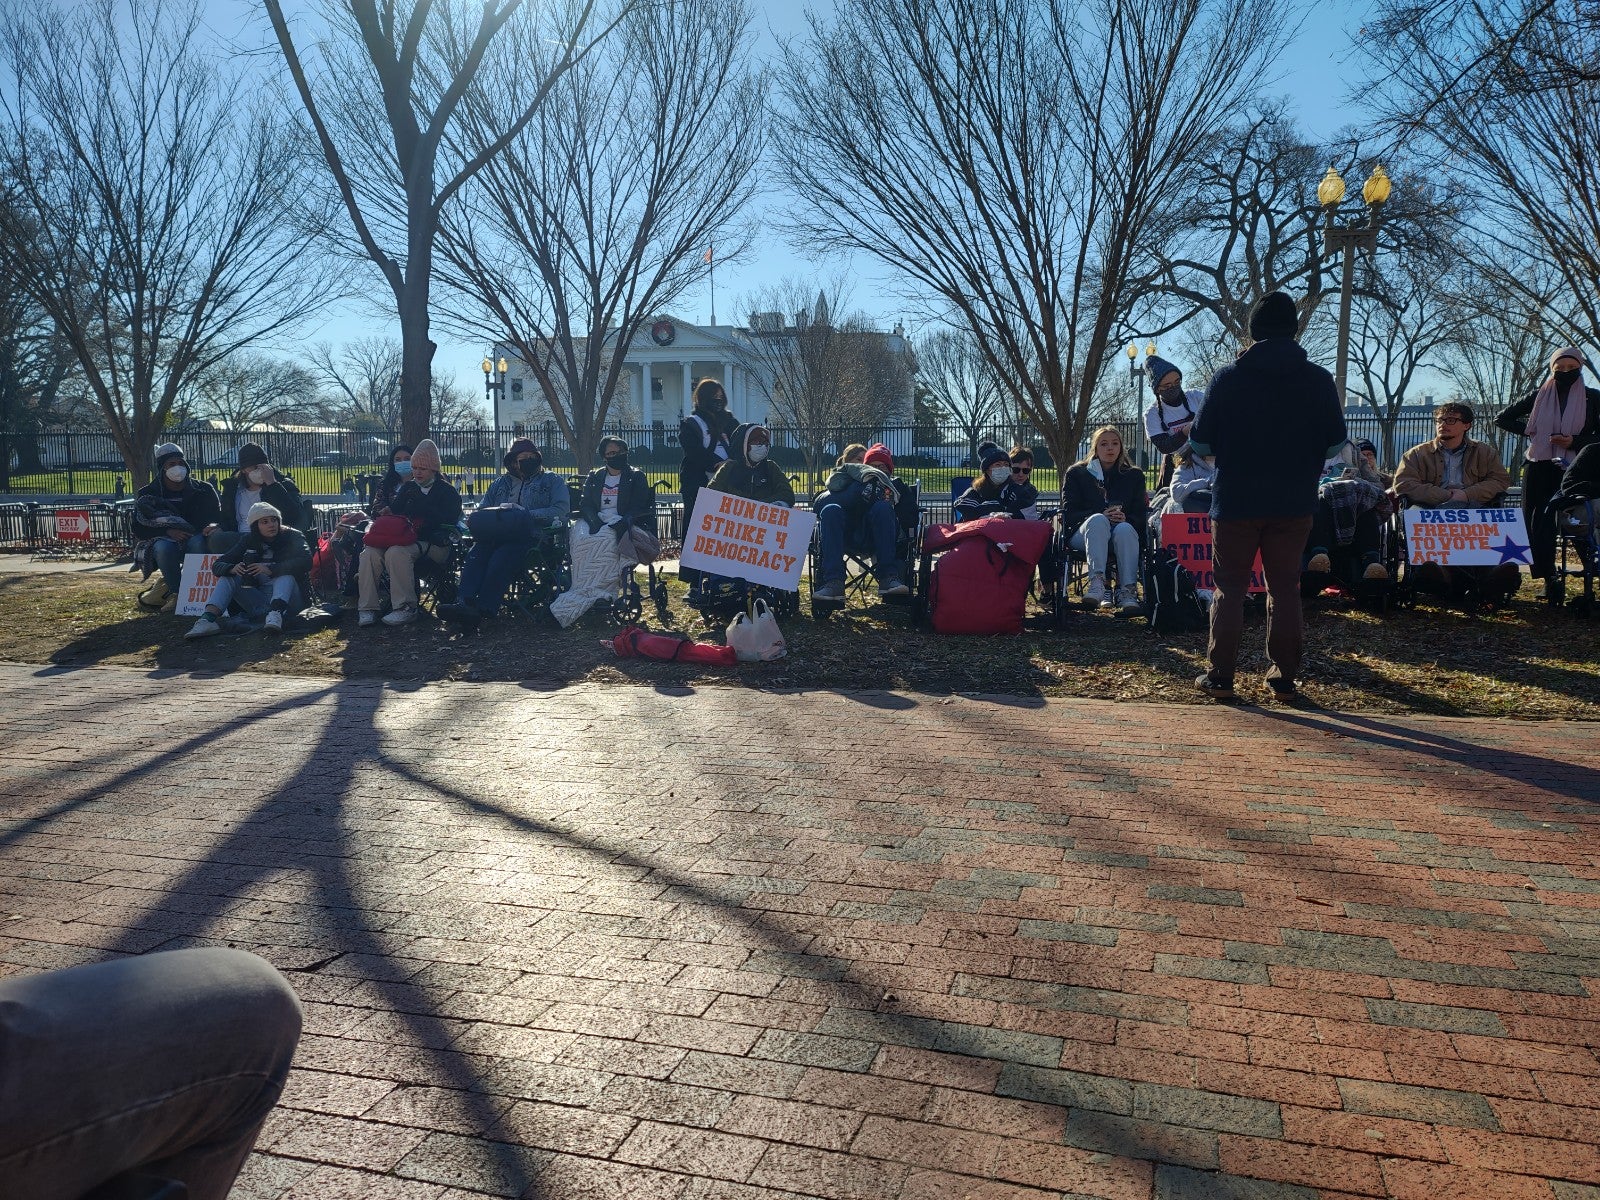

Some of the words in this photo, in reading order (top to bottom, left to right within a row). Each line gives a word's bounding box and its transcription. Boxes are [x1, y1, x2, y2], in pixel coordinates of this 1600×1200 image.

[719, 495, 790, 527] HUNGER
[1420, 509, 1470, 523] PASS
[1476, 508, 1517, 523] THE
[59, 518, 79, 527] EXIT
[1412, 523, 1500, 537] FREEDOM
[701, 514, 767, 545] STRIKE
[776, 531, 788, 550] 4
[1411, 537, 1436, 550] TO
[1440, 536, 1491, 550] VOTE
[693, 535, 797, 573] DEMOCRACY
[1167, 543, 1213, 561] STRI
[1412, 550, 1450, 565] ACT
[200, 554, 217, 570] AC
[187, 587, 215, 603] BID
